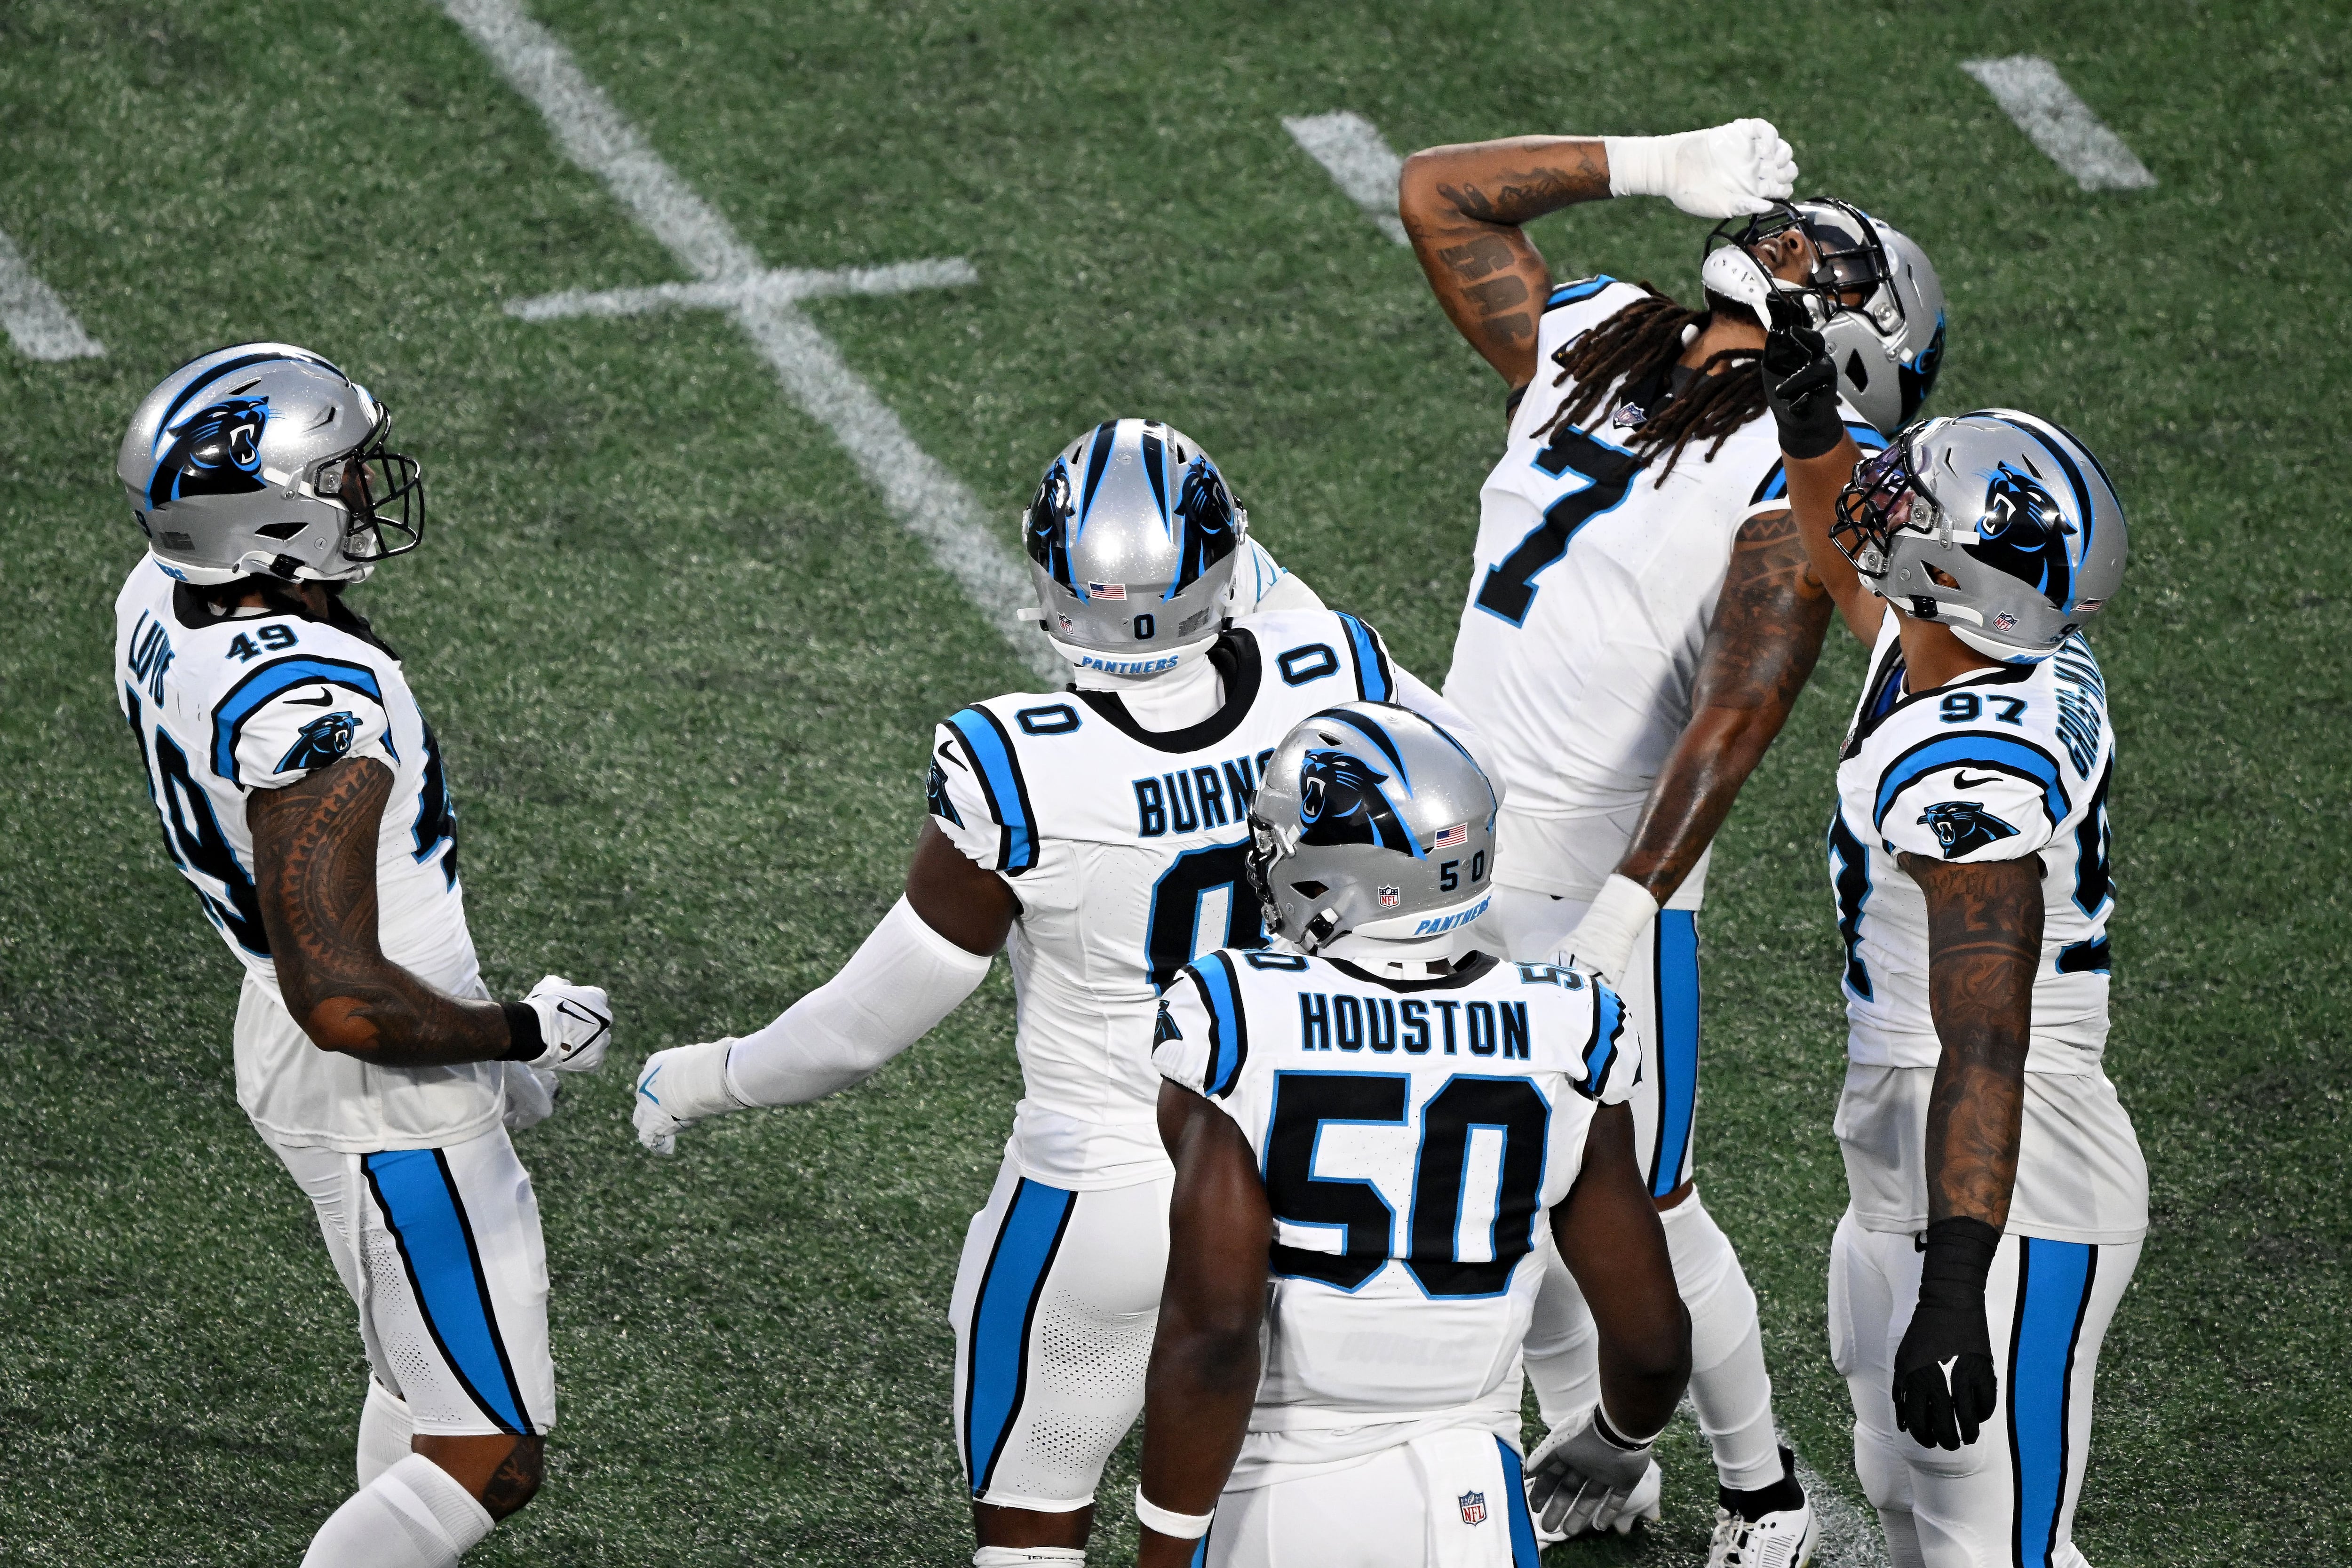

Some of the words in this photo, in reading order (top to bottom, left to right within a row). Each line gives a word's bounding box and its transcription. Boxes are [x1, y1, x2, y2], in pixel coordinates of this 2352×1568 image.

[1473, 425, 1646, 629] 7
[226, 623, 299, 663] 49
[1134, 613, 1156, 640] 0
[1081, 655, 1179, 674] PANTHERS
[1275, 643, 1340, 687] 0
[1013, 702, 1083, 736] 0
[1939, 692, 2028, 727] 97
[1440, 850, 1485, 892] 50
[1145, 836, 1274, 996] 0
[1381, 896, 1397, 906] NFL
[1414, 895, 1491, 935] PANTHER
[1511, 961, 1584, 992] 5
[1298, 991, 1531, 1061] HOUSTON
[1260, 1069, 1552, 1301] 50
[1463, 1505, 1485, 1523] NFL
